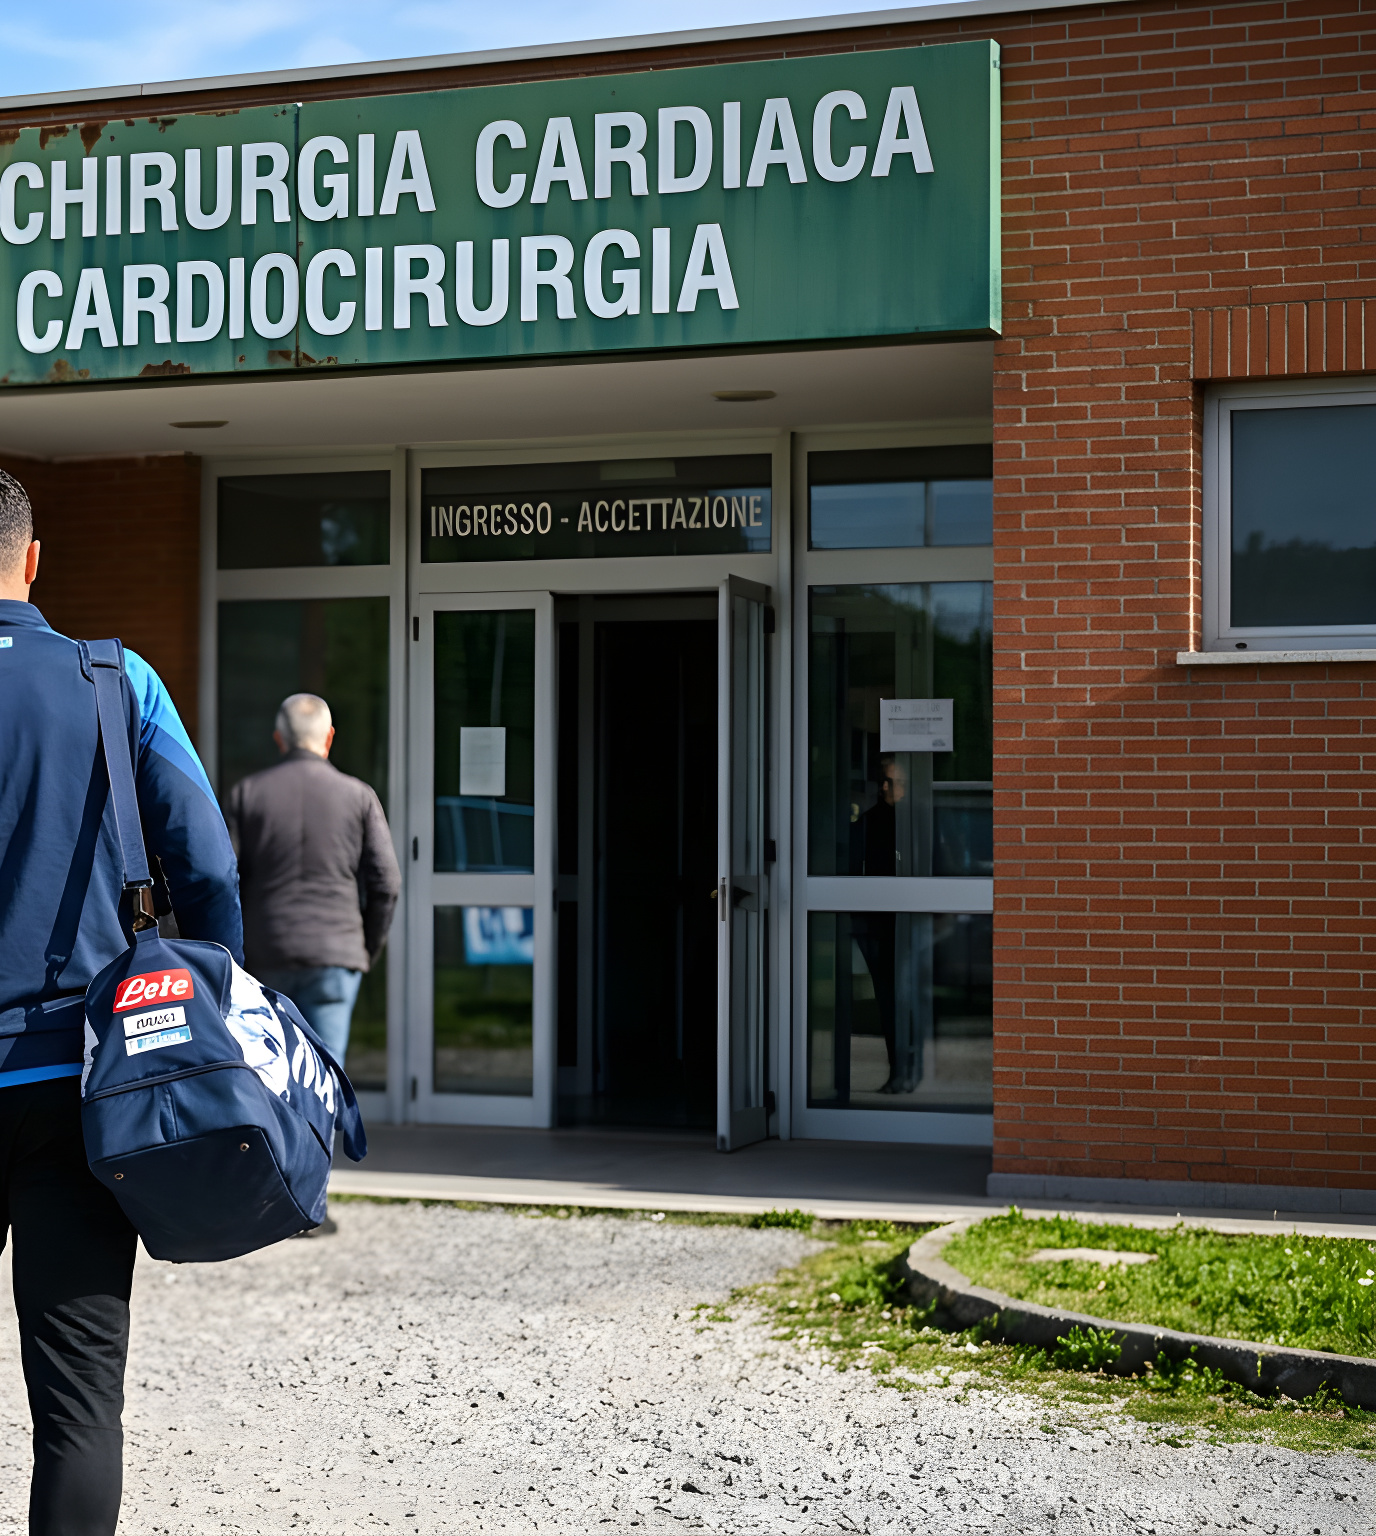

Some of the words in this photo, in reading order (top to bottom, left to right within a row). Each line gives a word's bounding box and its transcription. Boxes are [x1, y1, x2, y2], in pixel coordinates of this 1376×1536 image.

[475, 85, 935, 209] CARDIACA
[16, 223, 740, 354] CARDIOCIRURGIA
[430, 502, 552, 537] INGRESSO
[577, 495, 763, 532] ACCETTAZIONE
[115, 974, 189, 1009] Lete
